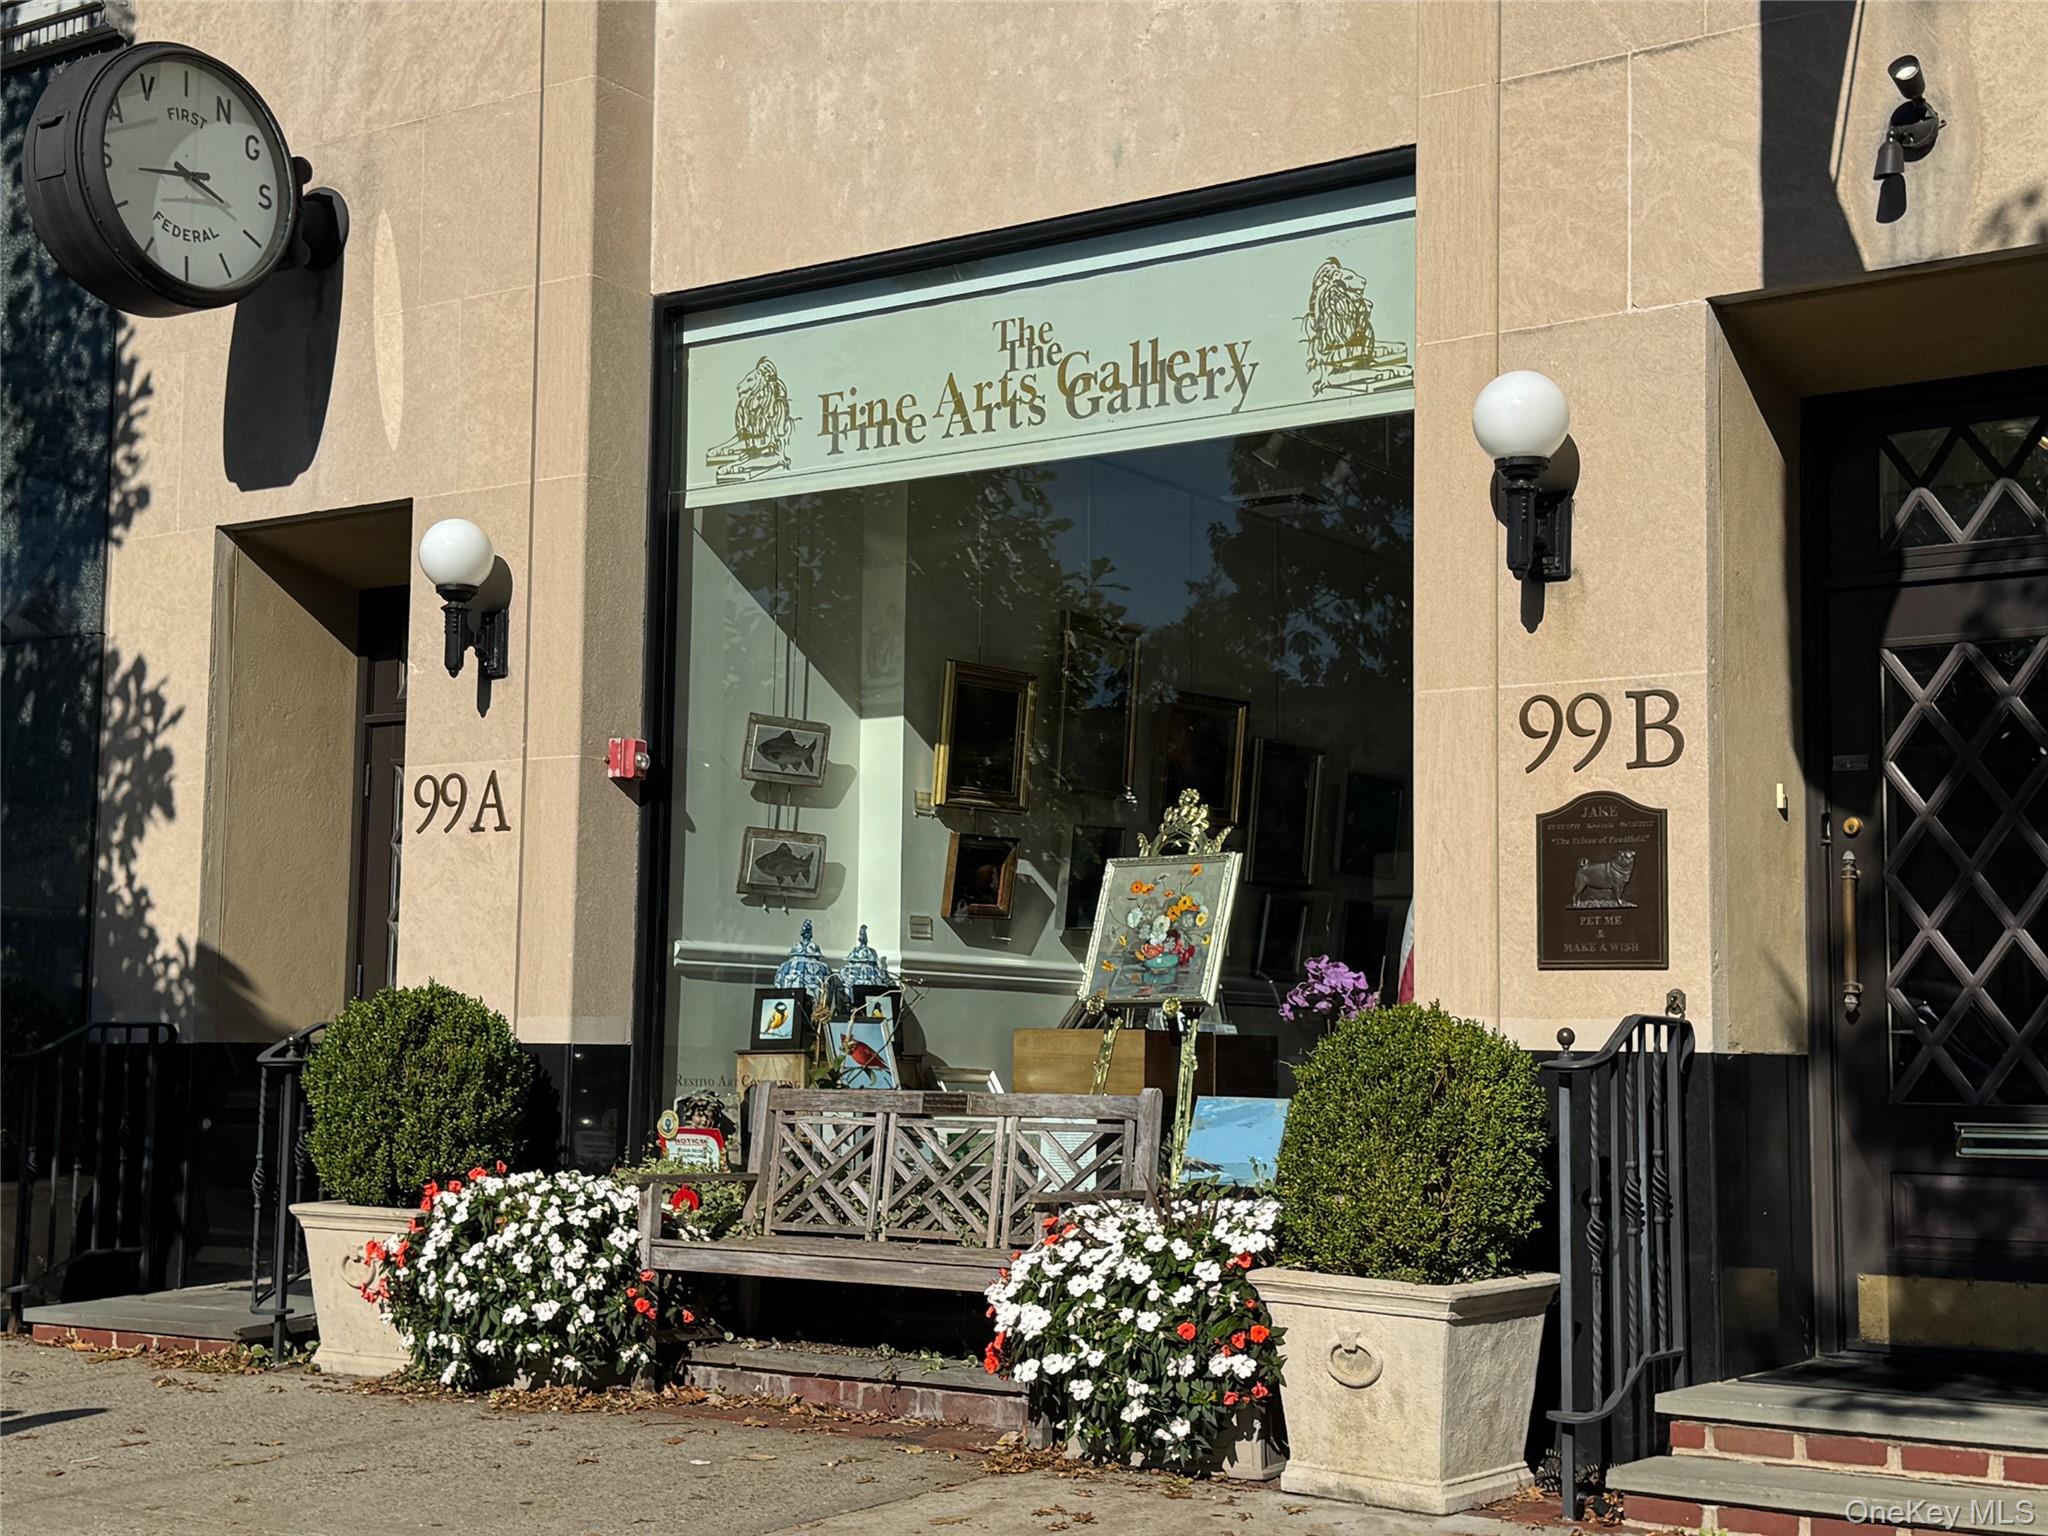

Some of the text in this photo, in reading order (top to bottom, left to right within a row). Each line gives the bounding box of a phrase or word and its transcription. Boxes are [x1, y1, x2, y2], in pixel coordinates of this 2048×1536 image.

[166, 106, 209, 130] FIRST
[152, 210, 220, 243] FEDERAL
[993, 317, 1054, 353] The
[818, 337, 1252, 437] Fine Arts Gallery
[413, 769, 512, 835] 99A
[1581, 805, 1619, 818] JAKE
[1579, 914, 1623, 926] PET ME
[1563, 942, 1641, 953] MAKE A WISH
